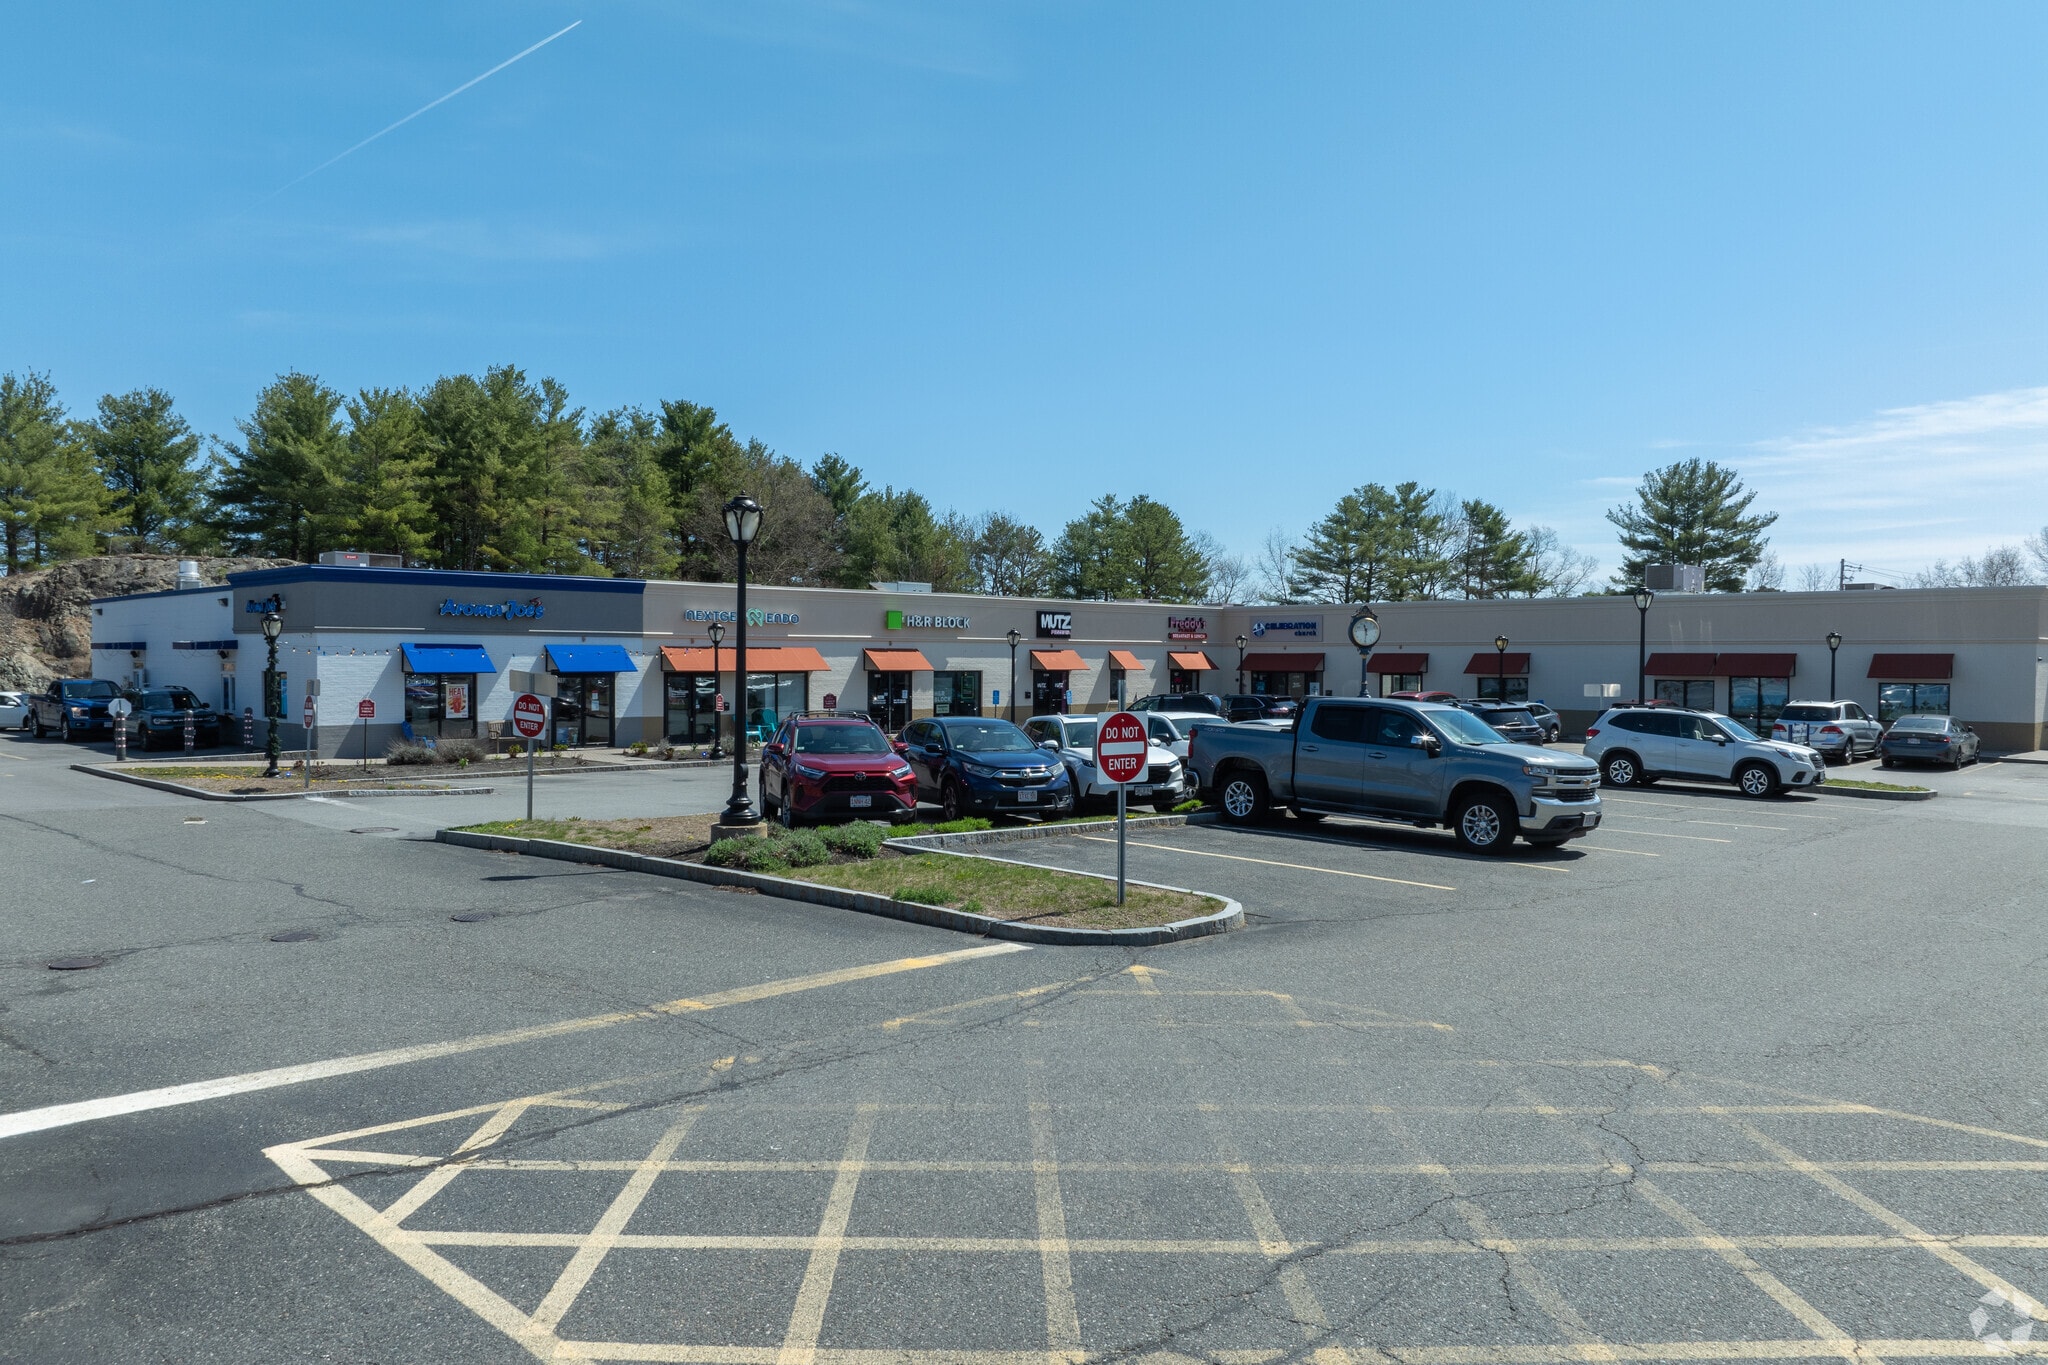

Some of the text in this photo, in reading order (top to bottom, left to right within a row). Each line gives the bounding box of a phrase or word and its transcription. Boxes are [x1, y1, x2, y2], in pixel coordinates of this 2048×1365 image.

[440, 598, 503, 618] Aroma
[765, 612, 800, 624] ENDO
[906, 615, 970, 628] H&R BLOCK
[1041, 613, 1071, 629] MUTZ
[449, 687, 465, 696] HEAT
[518, 701, 540, 712] DO NOT
[520, 720, 539, 731] ENTER
[1106, 726, 1139, 739] DO NOT
[1108, 757, 1137, 771] ENTER
